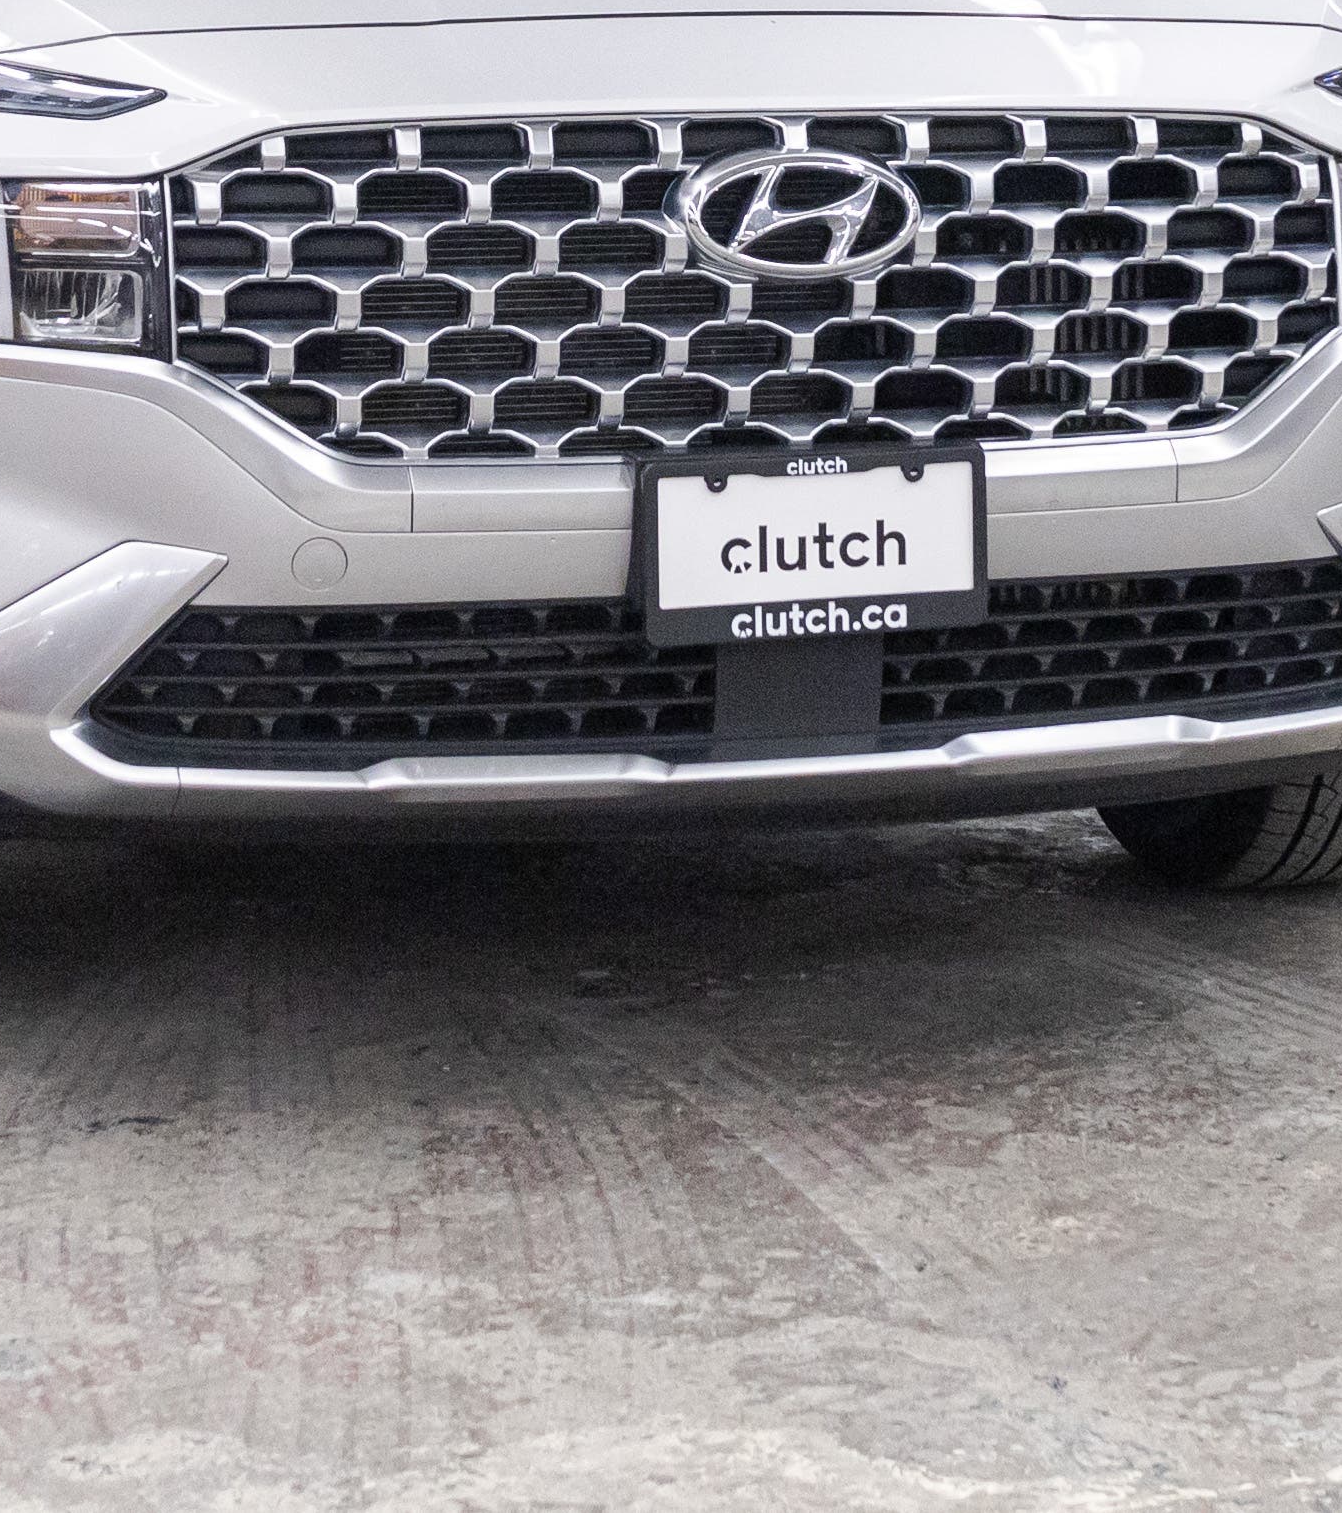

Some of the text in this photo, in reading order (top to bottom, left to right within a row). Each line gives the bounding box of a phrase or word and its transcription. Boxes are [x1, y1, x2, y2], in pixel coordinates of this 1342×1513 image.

[786, 456, 848, 475] clutch
[720, 519, 907, 574] clutch
[730, 600, 908, 639] clutch.ca
